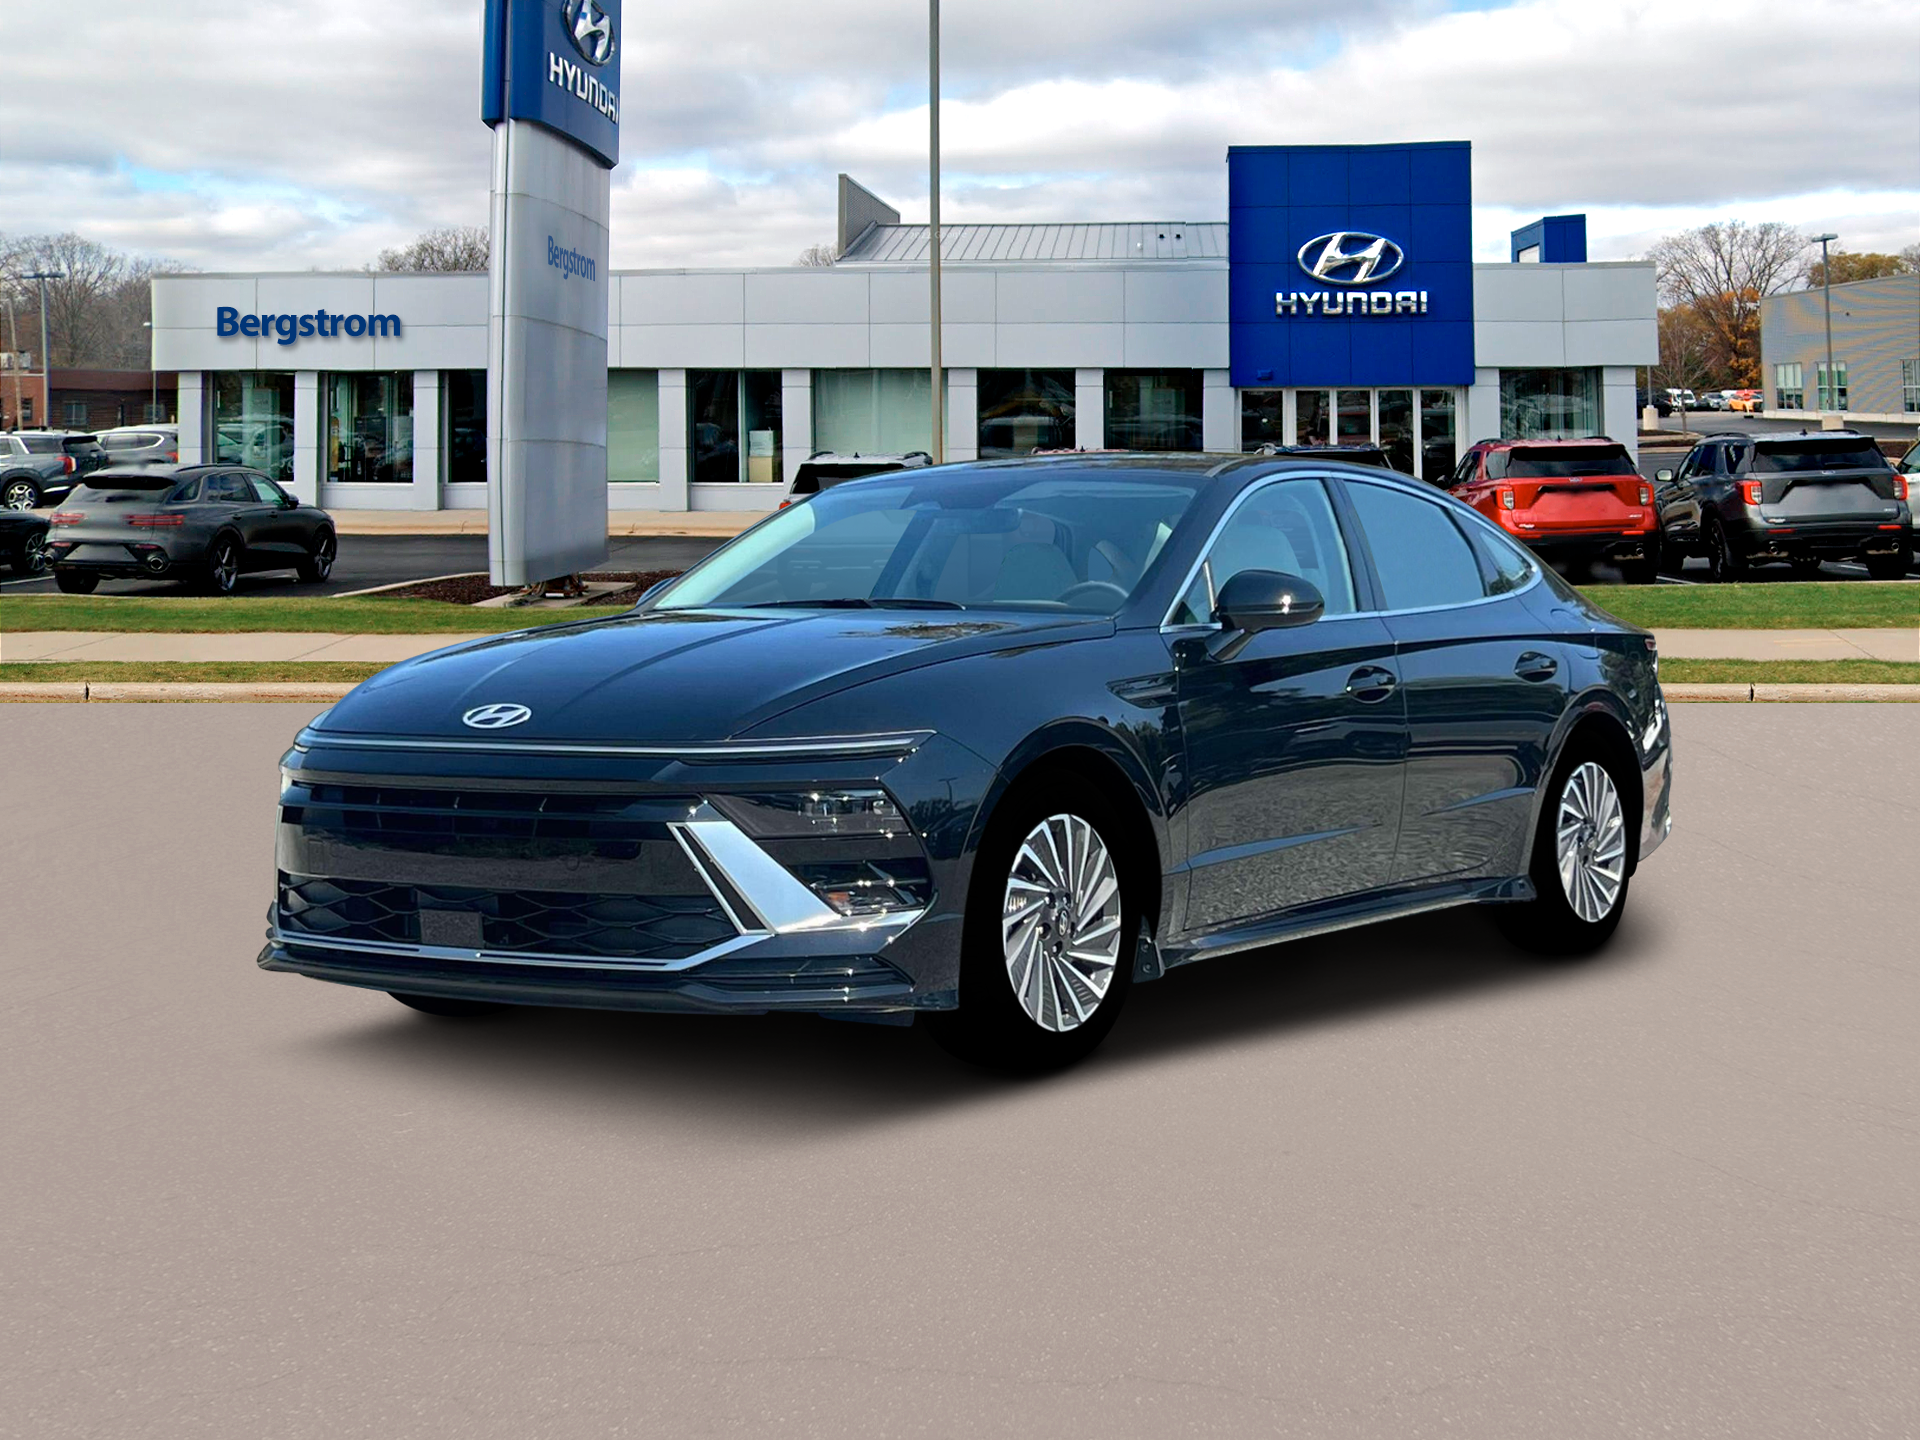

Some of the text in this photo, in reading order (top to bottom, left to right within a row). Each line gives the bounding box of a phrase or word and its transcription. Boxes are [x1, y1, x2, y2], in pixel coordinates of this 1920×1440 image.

[548, 52, 619, 124] HYUNDAI
[547, 235, 596, 282] Bergstrom
[1275, 290, 1428, 316] HYUNDAI
[216, 306, 402, 346] Bergstrom
